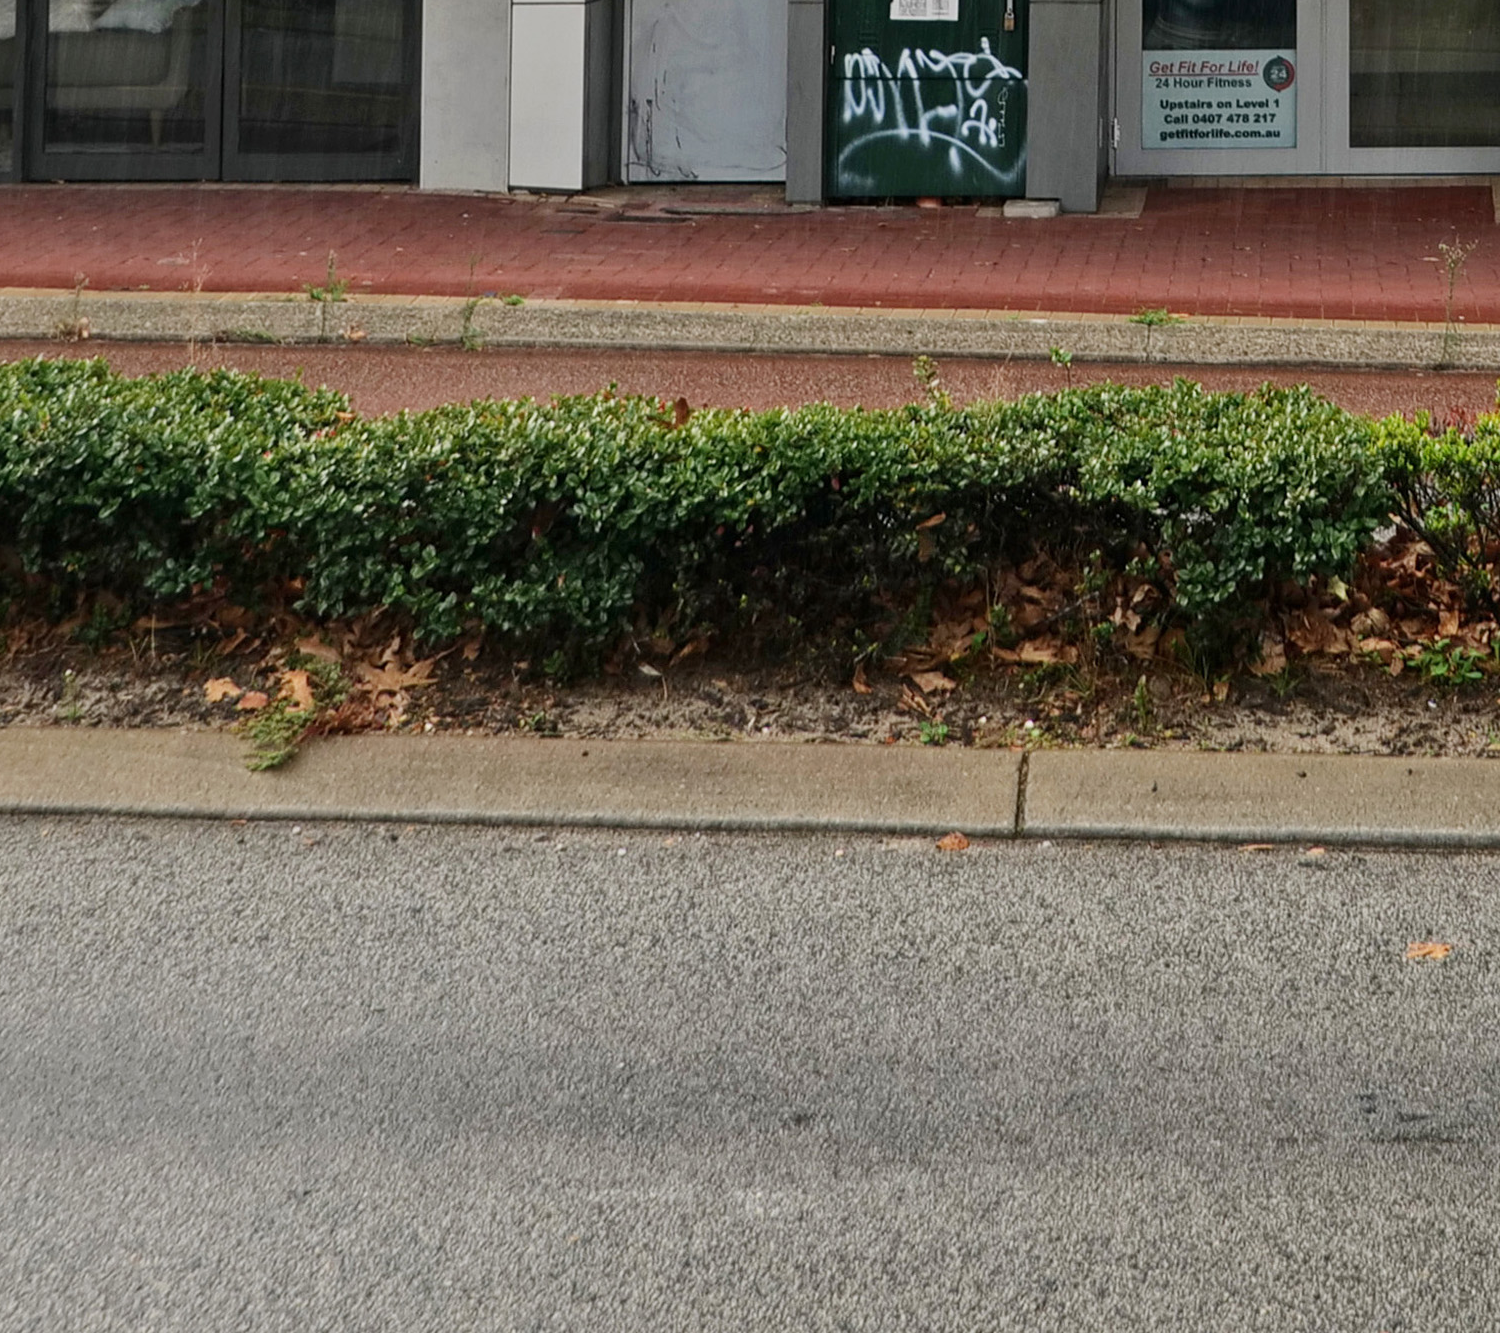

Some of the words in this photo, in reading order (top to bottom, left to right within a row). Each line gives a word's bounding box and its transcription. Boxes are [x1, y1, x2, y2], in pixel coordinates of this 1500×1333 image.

[1149, 60, 1174, 73] Get
[1178, 60, 1196, 73] Fit
[1200, 60, 1224, 73] For
[1228, 60, 1259, 73] Life!
[1155, 78, 1169, 88] 24
[1173, 77, 1203, 88] Hour
[1207, 77, 1252, 88] Fitness
[1160, 99, 1213, 111] Upstairs
[1217, 100, 1232, 108] on
[1236, 98, 1269, 108] Level
[1273, 98, 1280, 108] 1
[1164, 114, 1188, 124] Call
[1192, 114, 1222, 124] 0407
[1226, 114, 1249, 124] 478
[1253, 113, 1276, 123] 217
[1160, 128, 1281, 141] getfitforlife.com.au
